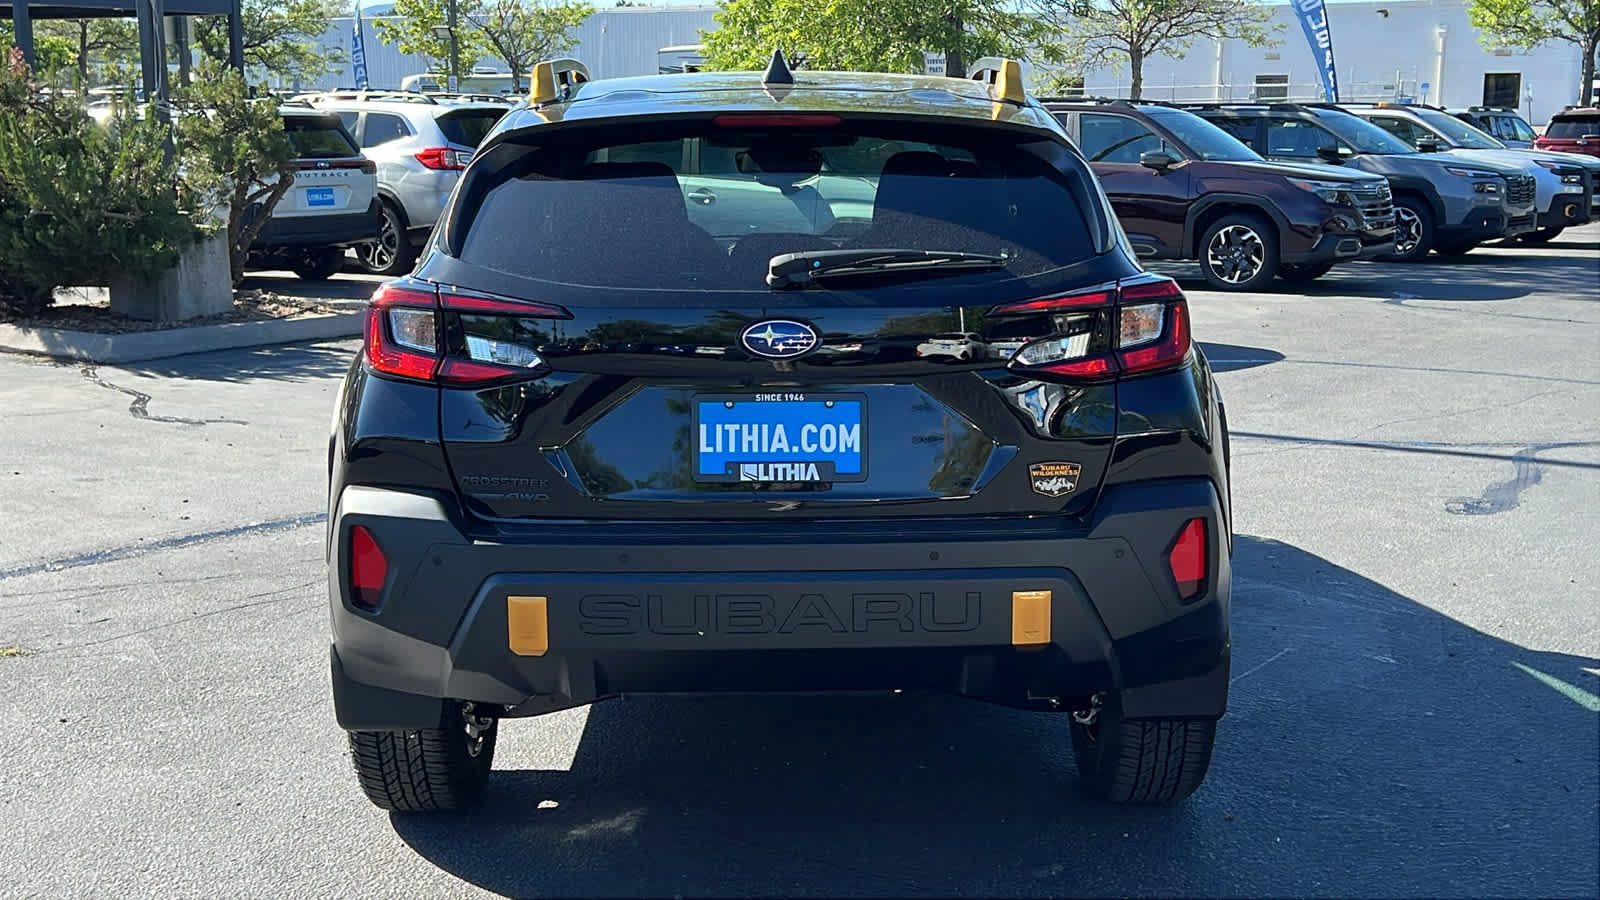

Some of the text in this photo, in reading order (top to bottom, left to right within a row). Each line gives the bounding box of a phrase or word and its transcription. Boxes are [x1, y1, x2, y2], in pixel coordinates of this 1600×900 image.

[755, 393, 805, 402] SINCE 1946
[699, 423, 861, 453] LITHIA.COM
[462, 475, 549, 487] CROSSTREK
[758, 463, 820, 481] LITHIA
[578, 591, 982, 636] SUBARU
